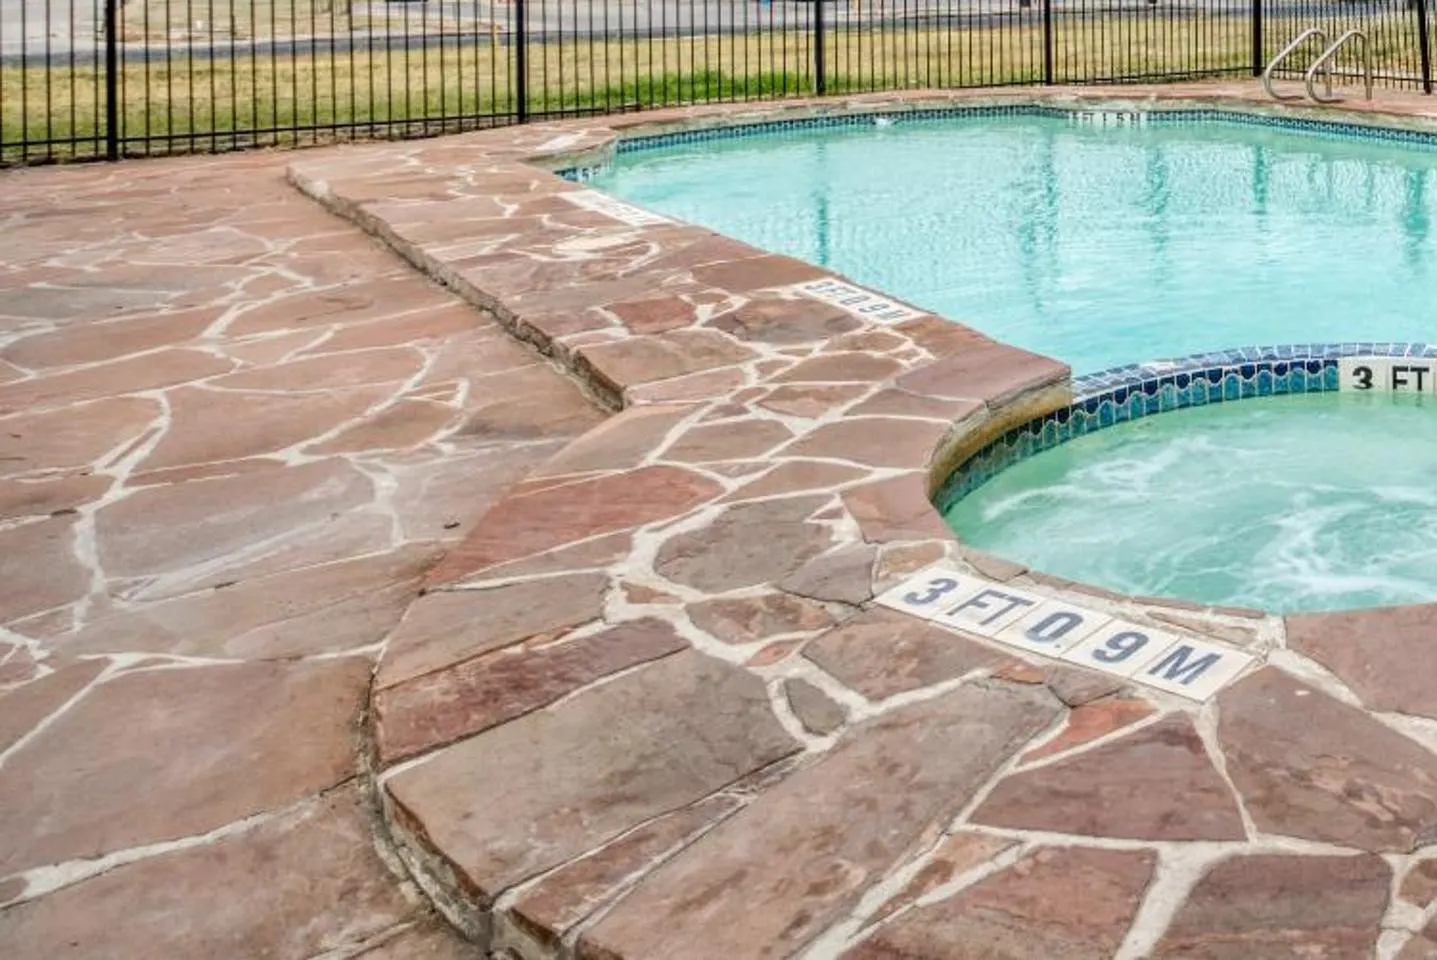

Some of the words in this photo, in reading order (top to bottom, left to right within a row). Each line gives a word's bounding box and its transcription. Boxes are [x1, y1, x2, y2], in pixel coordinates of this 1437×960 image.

[1352, 366, 1374, 390] 3
[1391, 365, 1430, 392] FT
[903, 576, 959, 606] 3
[946, 588, 1036, 626] FT
[1147, 644, 1223, 685] M
